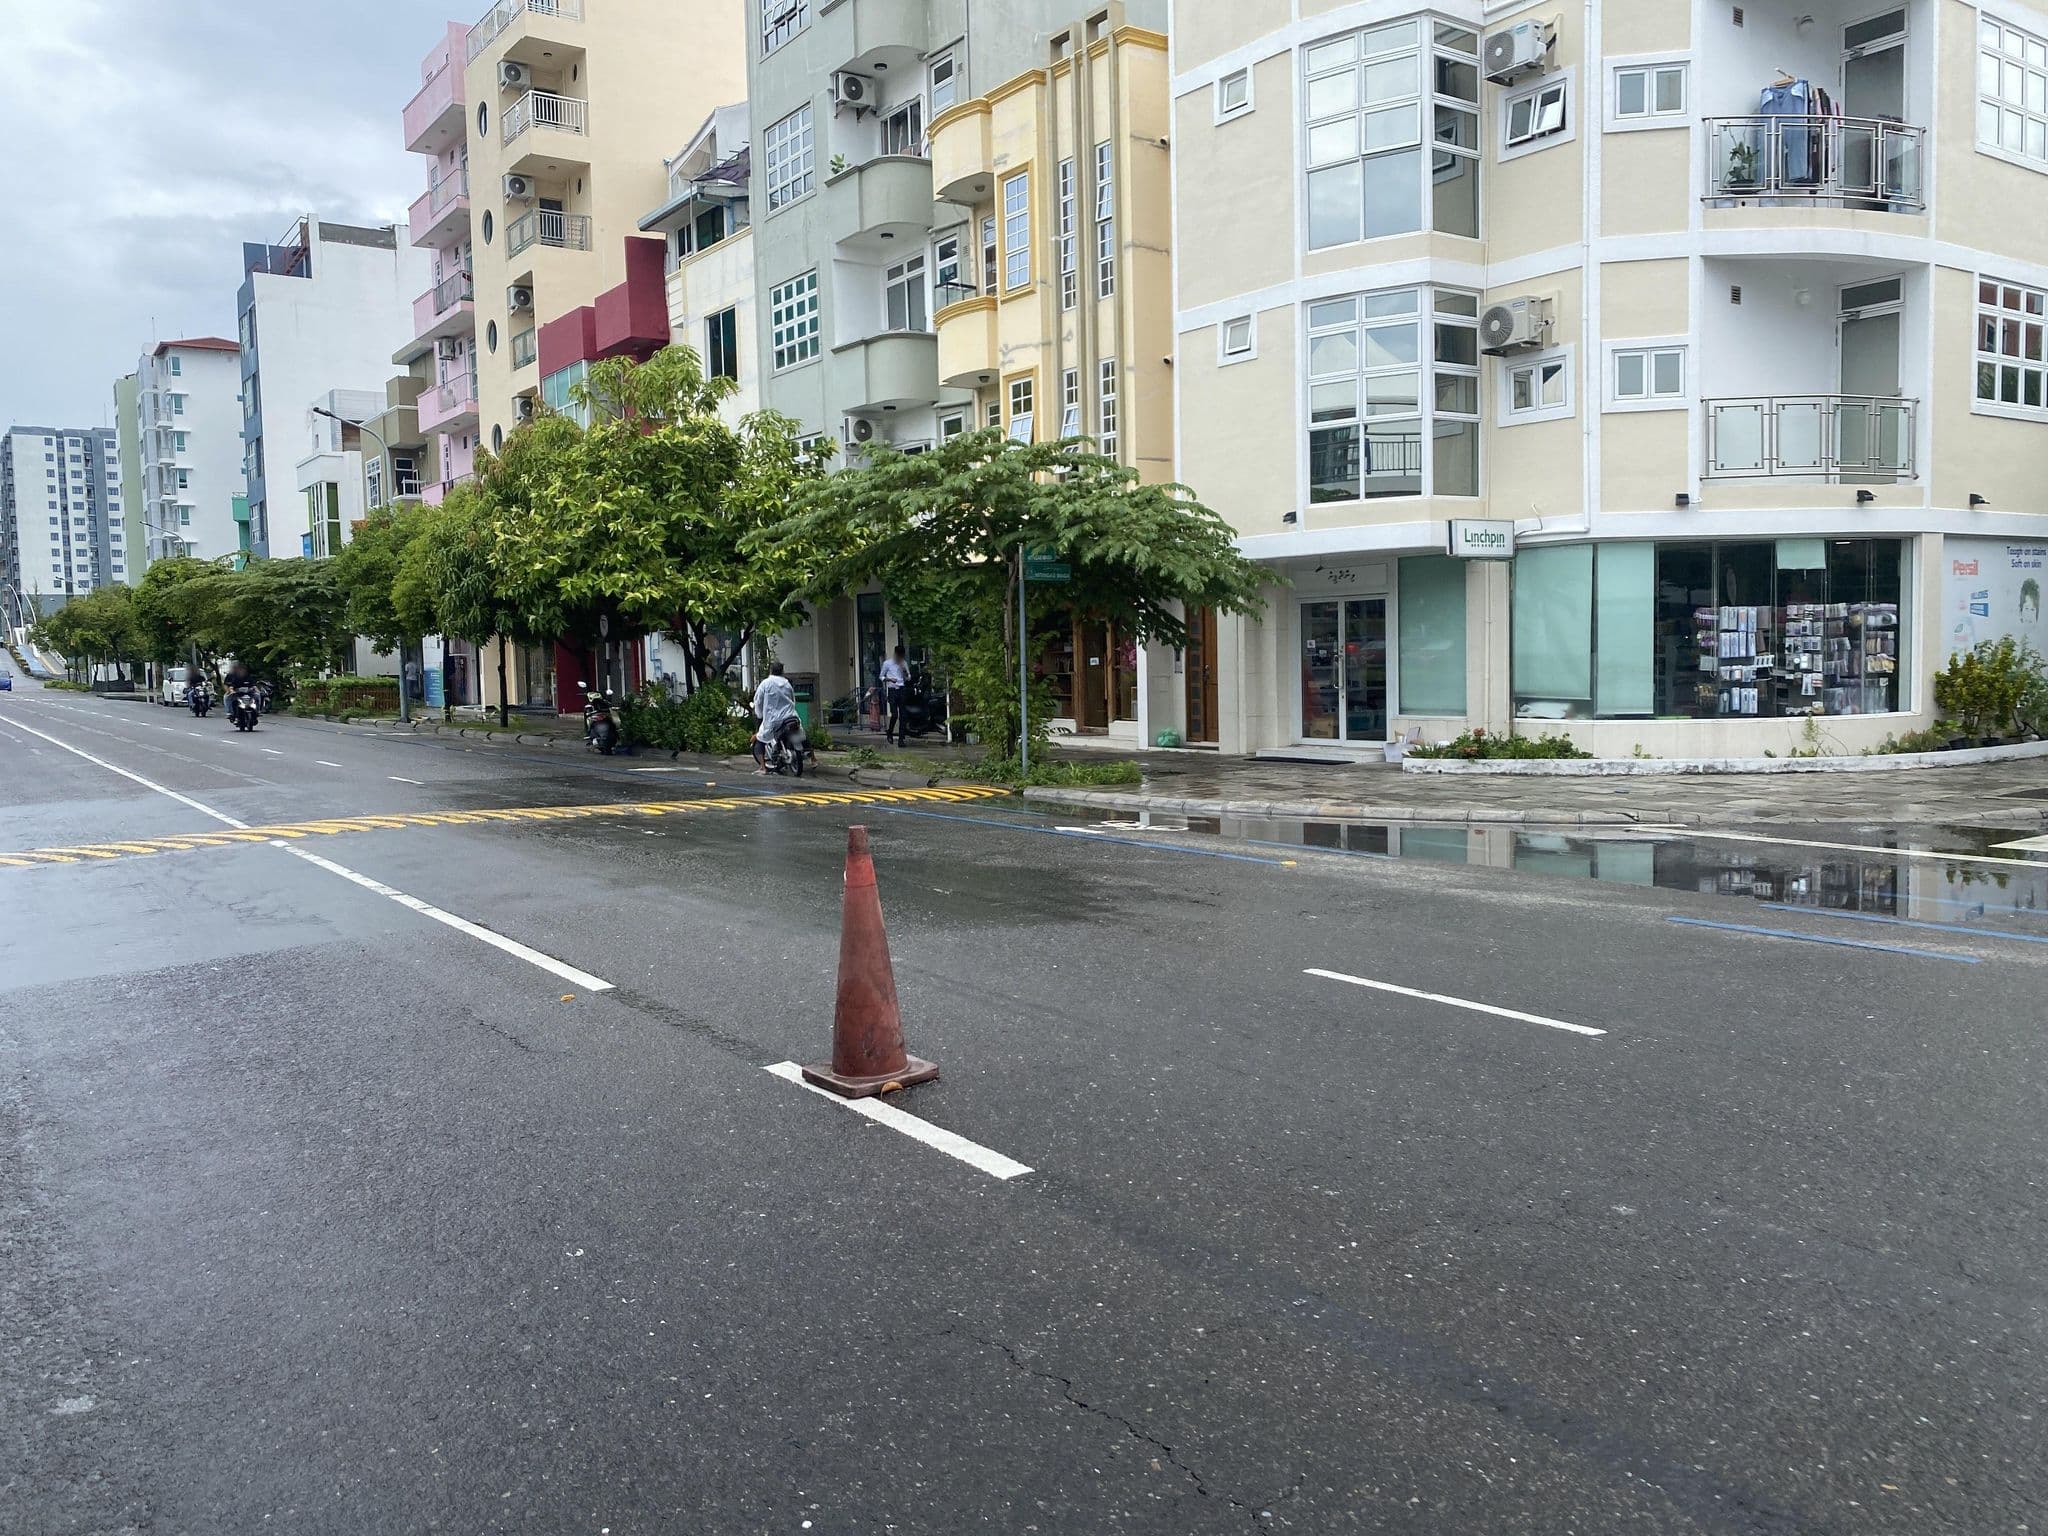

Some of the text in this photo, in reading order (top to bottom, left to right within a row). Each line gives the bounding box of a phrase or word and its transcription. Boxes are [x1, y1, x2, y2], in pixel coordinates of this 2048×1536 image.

[1464, 528, 1505, 545] Linchpin
[2006, 546, 2023, 557] Tough
[2024, 548, 2031, 556] on
[2011, 558, 2023, 568] Soft
[2023, 560, 2031, 568] on
